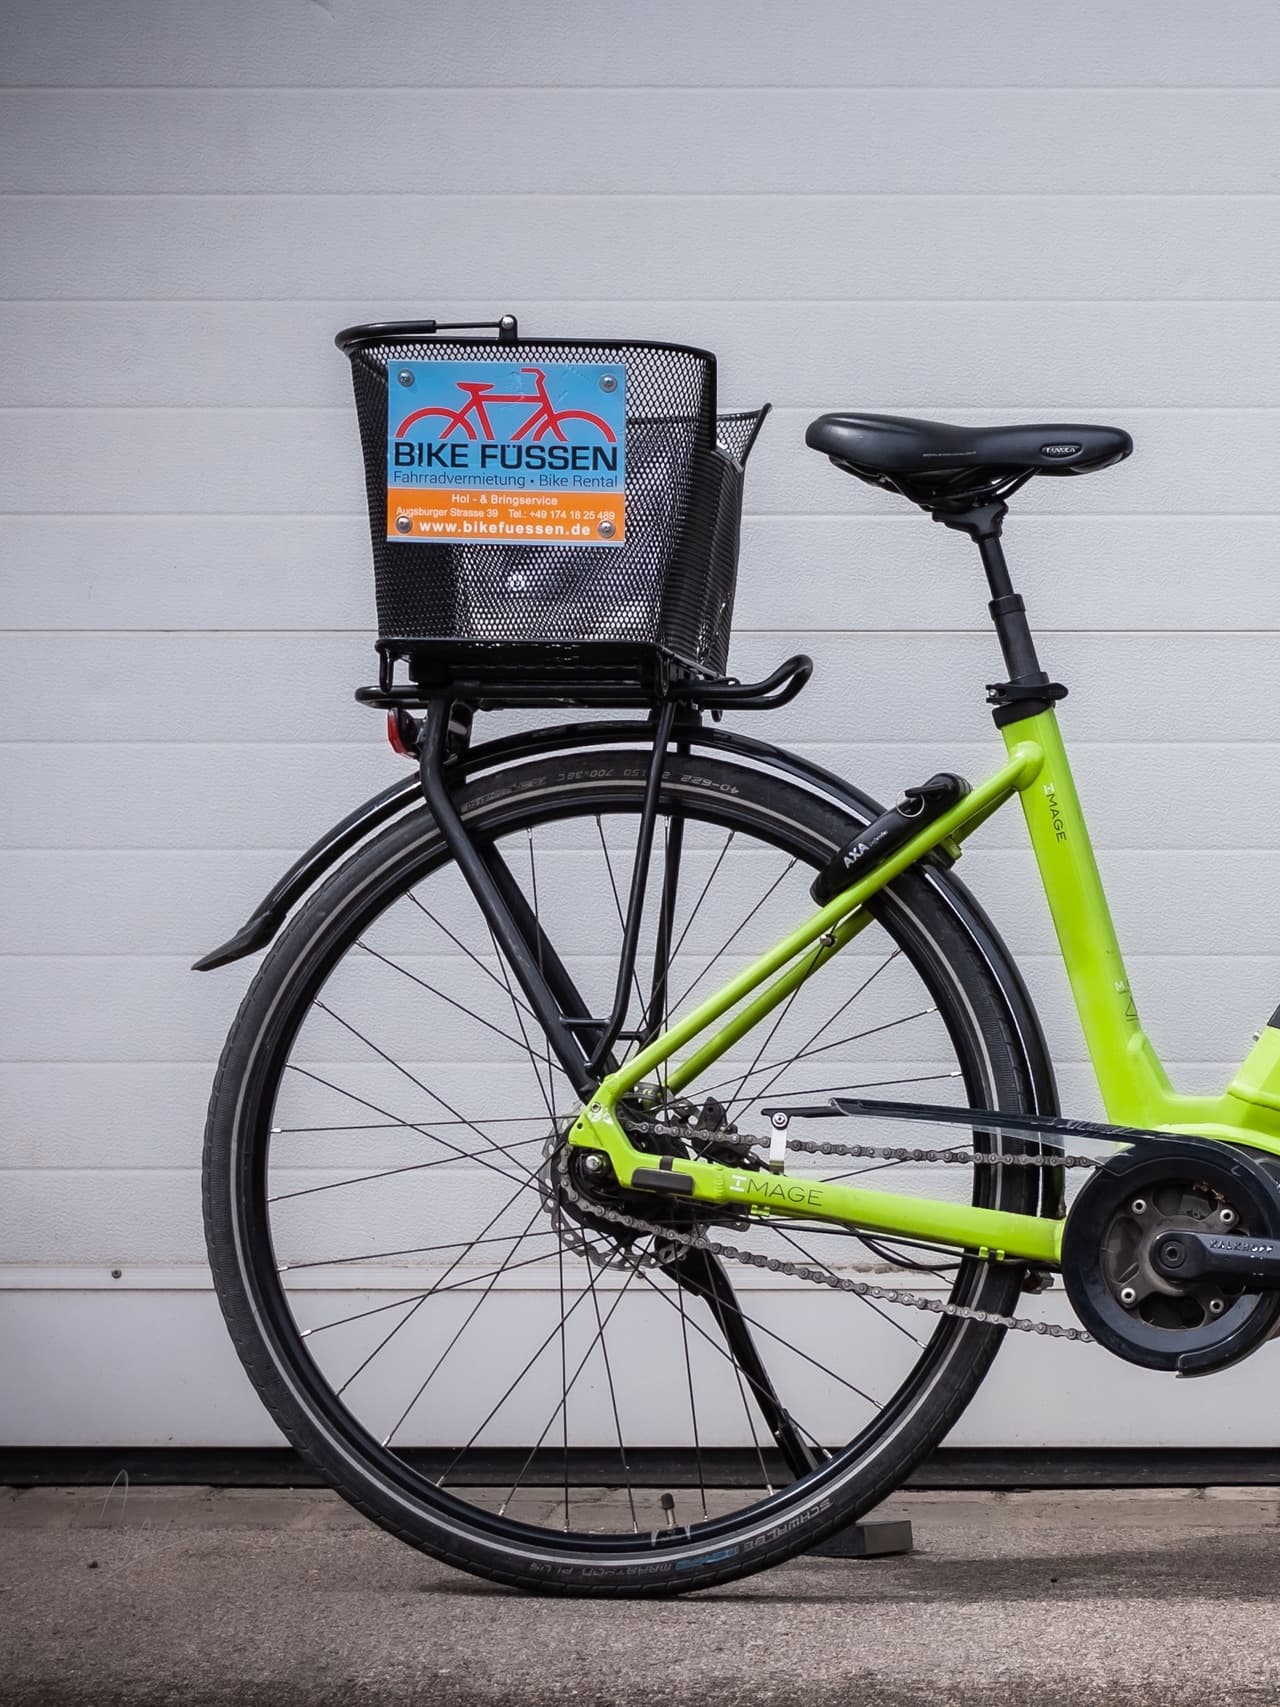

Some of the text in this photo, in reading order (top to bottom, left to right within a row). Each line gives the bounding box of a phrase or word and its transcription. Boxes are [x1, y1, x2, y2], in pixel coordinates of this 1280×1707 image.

[394, 442, 618, 471] BIKE FÜSSEN
[393, 470, 618, 488] Fahrradvermietung Bike Rental
[451, 494, 470, 504] Hol
[480, 495, 488, 504] &
[490, 495, 558, 508] Bringservice
[395, 506, 499, 518] Augsburger Strasse 39
[529, 511, 547, 519] +49
[551, 511, 567, 519] 174
[419, 520, 592, 537] www.bikefuessen.de
[1043, 784, 1067, 843] IMAGE
[843, 843, 870, 869] AXA
[729, 1174, 824, 1207] IMAGE
